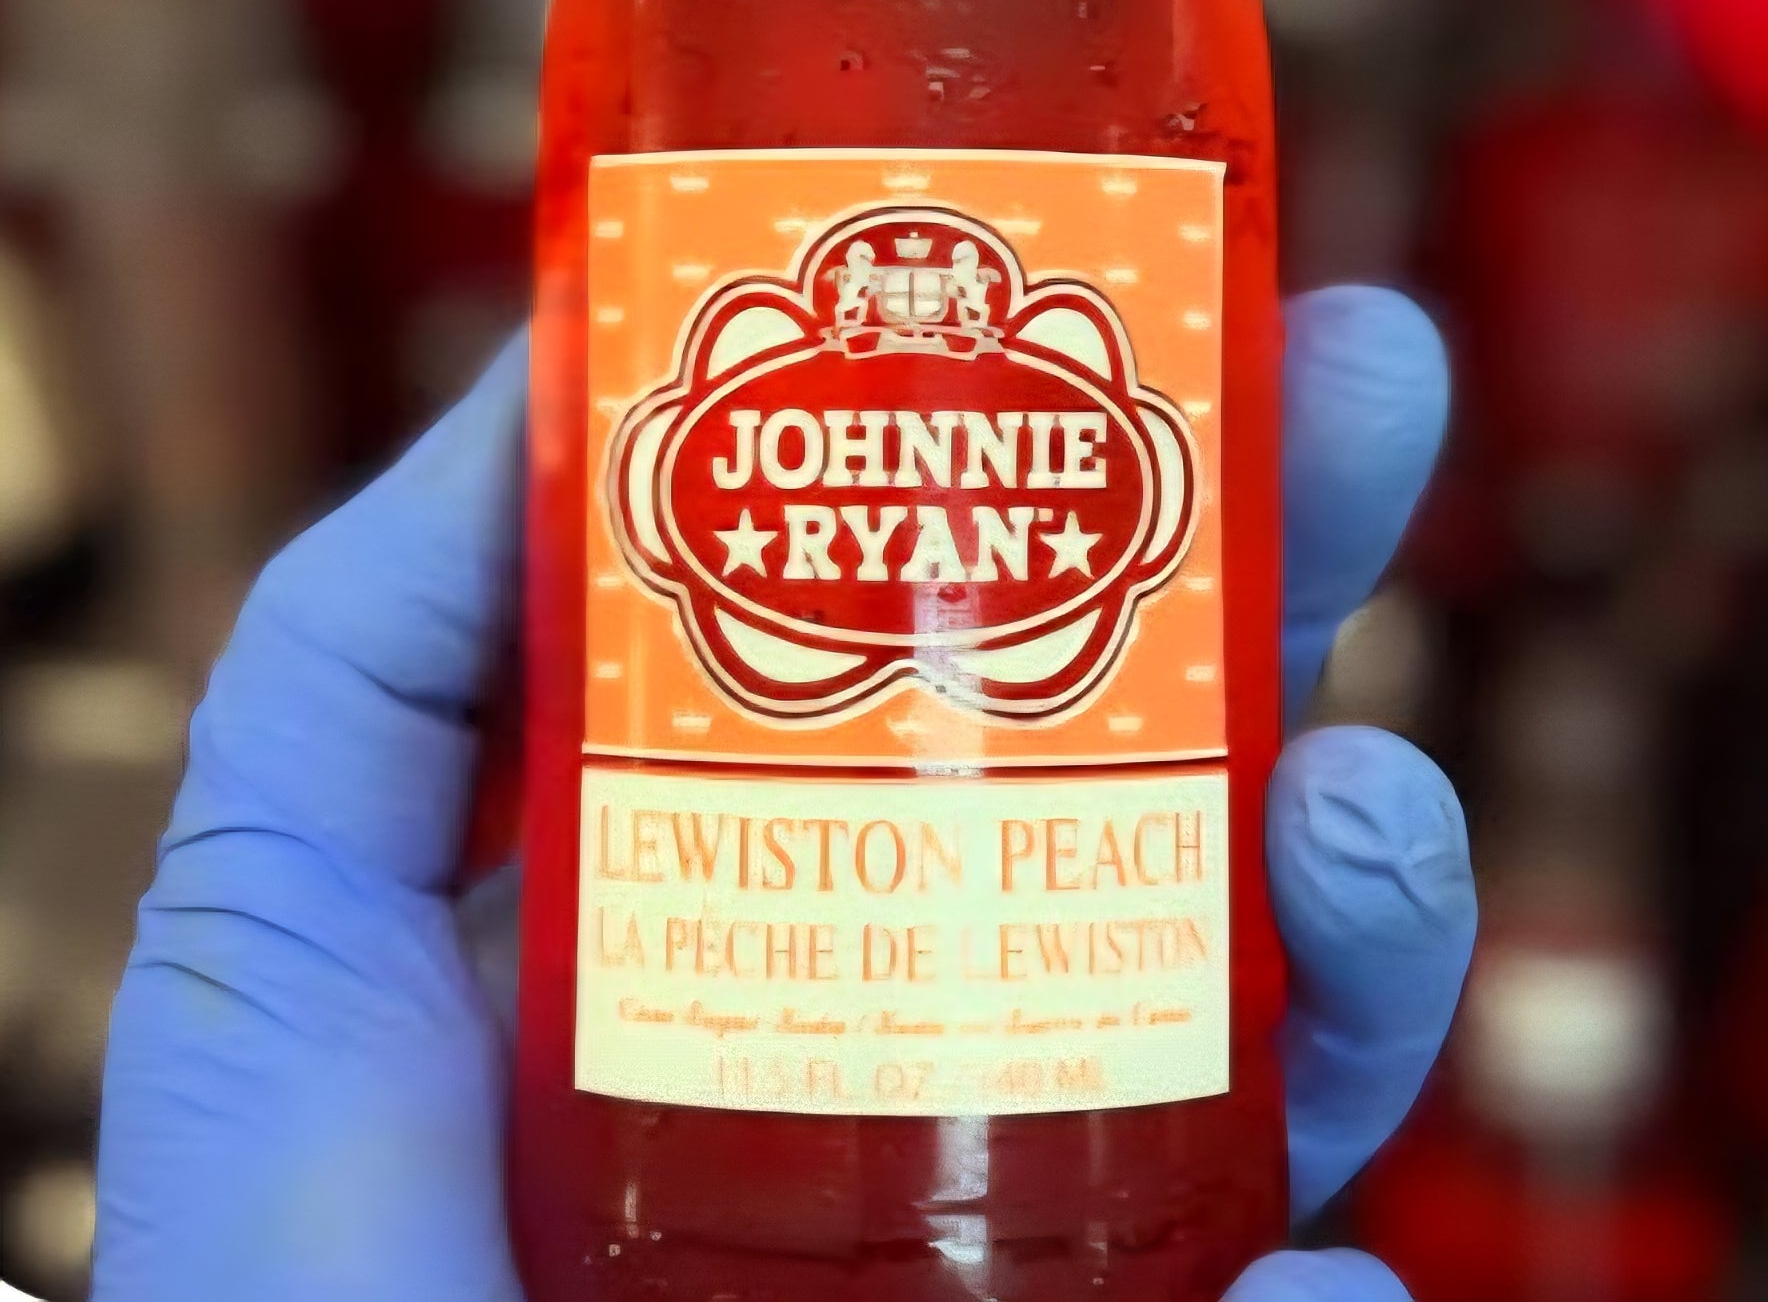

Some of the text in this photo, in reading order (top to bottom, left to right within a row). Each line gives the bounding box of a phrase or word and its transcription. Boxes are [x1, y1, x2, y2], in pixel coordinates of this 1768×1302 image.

[711, 408, 1108, 490] JOHNNIE
[782, 504, 1035, 583] RYAN
[597, 804, 1204, 894] LEWISTON PEACH
[861, 921, 940, 983] DE
[962, 917, 1208, 982] LEWISTON
